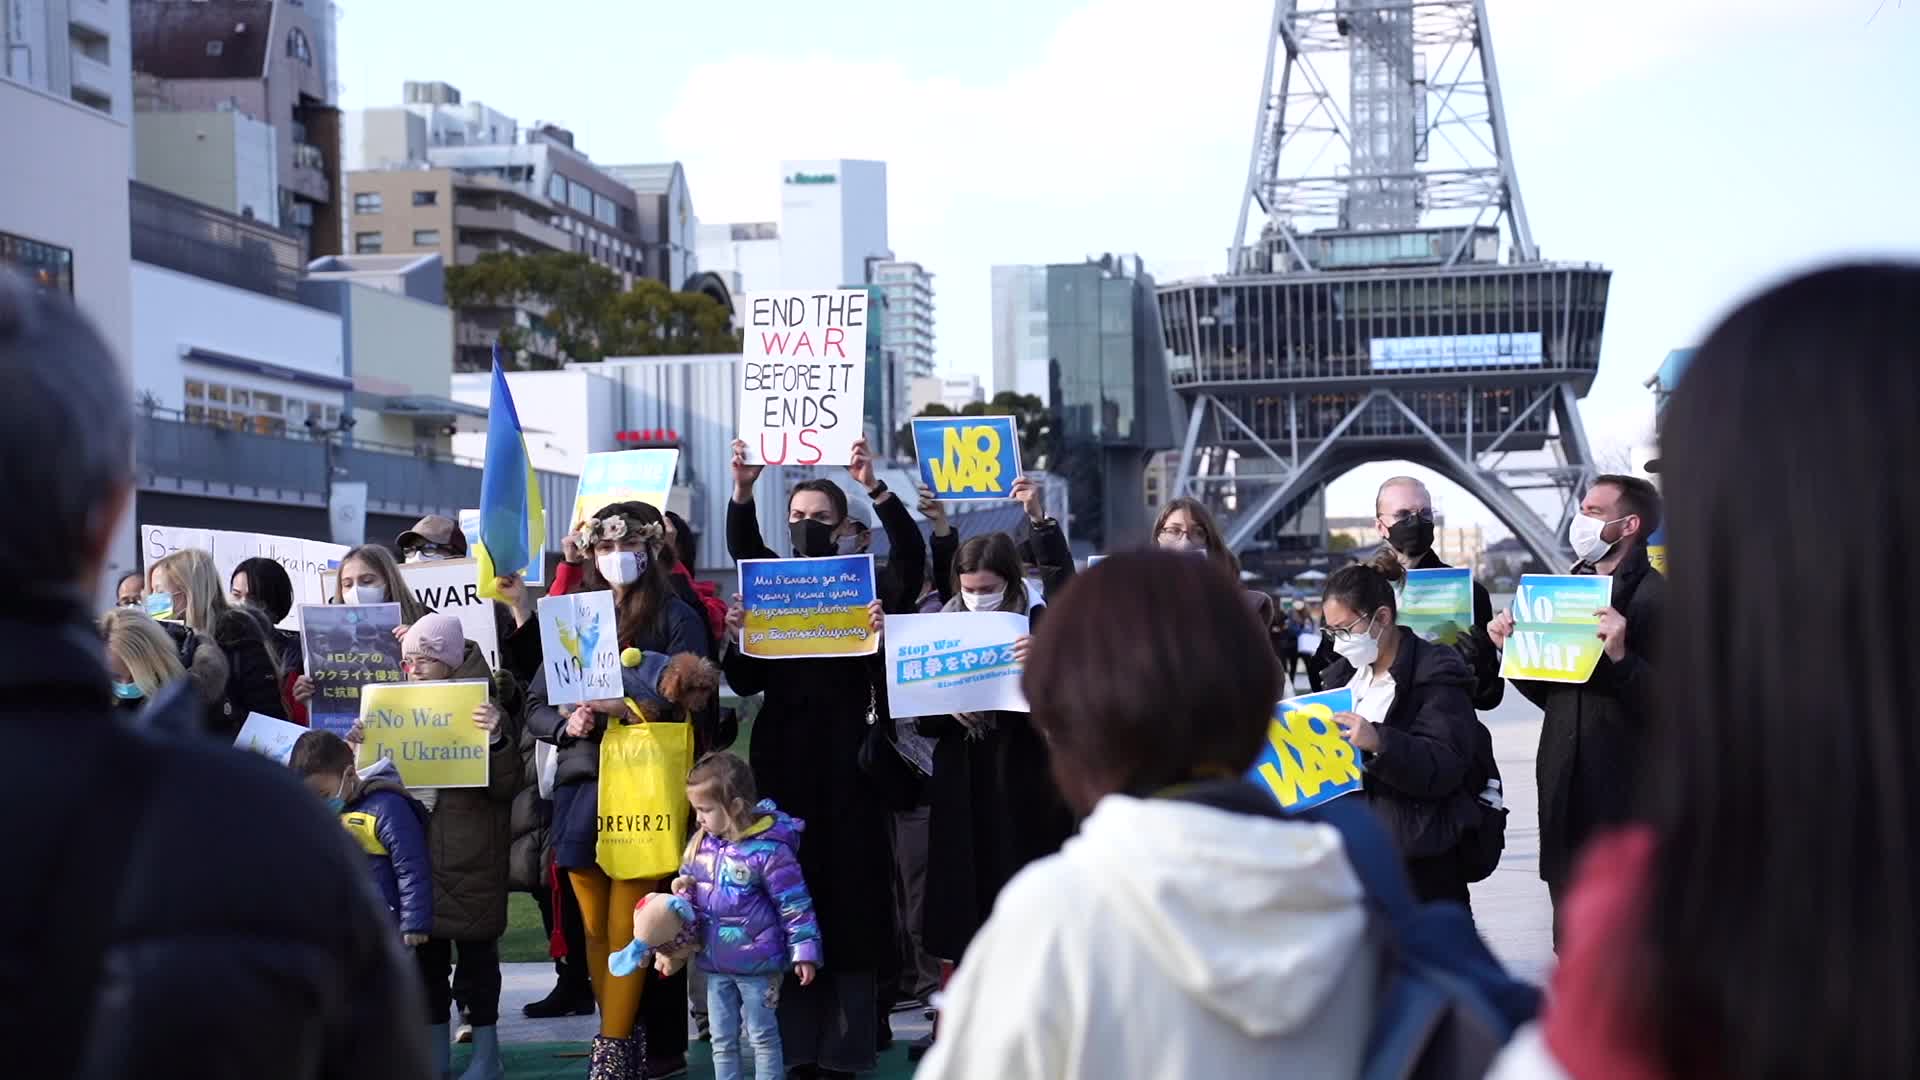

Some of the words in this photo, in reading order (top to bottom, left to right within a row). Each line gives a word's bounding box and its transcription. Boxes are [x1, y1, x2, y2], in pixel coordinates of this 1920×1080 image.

[753, 297, 805, 328] END
[812, 294, 864, 328] THE
[761, 327, 846, 358] WAR
[744, 362, 821, 392] BEFORE
[828, 363, 854, 393] IT
[763, 394, 838, 429] ENDS
[760, 428, 822, 465] US
[943, 425, 1001, 466] NO
[928, 457, 1003, 493] WAR
[415, 583, 483, 608] WAR
[1513, 585, 1553, 624] No
[898, 644, 930, 662] Stop
[934, 639, 961, 650] War
[1514, 631, 1584, 672] War
[554, 655, 584, 689] NO
[364, 709, 404, 729] #No
[409, 707, 453, 728] War
[401, 739, 484, 761] Ukraine
[1257, 737, 1361, 808] WAR
[596, 814, 650, 832] OREVER
[655, 813, 671, 832] 21
